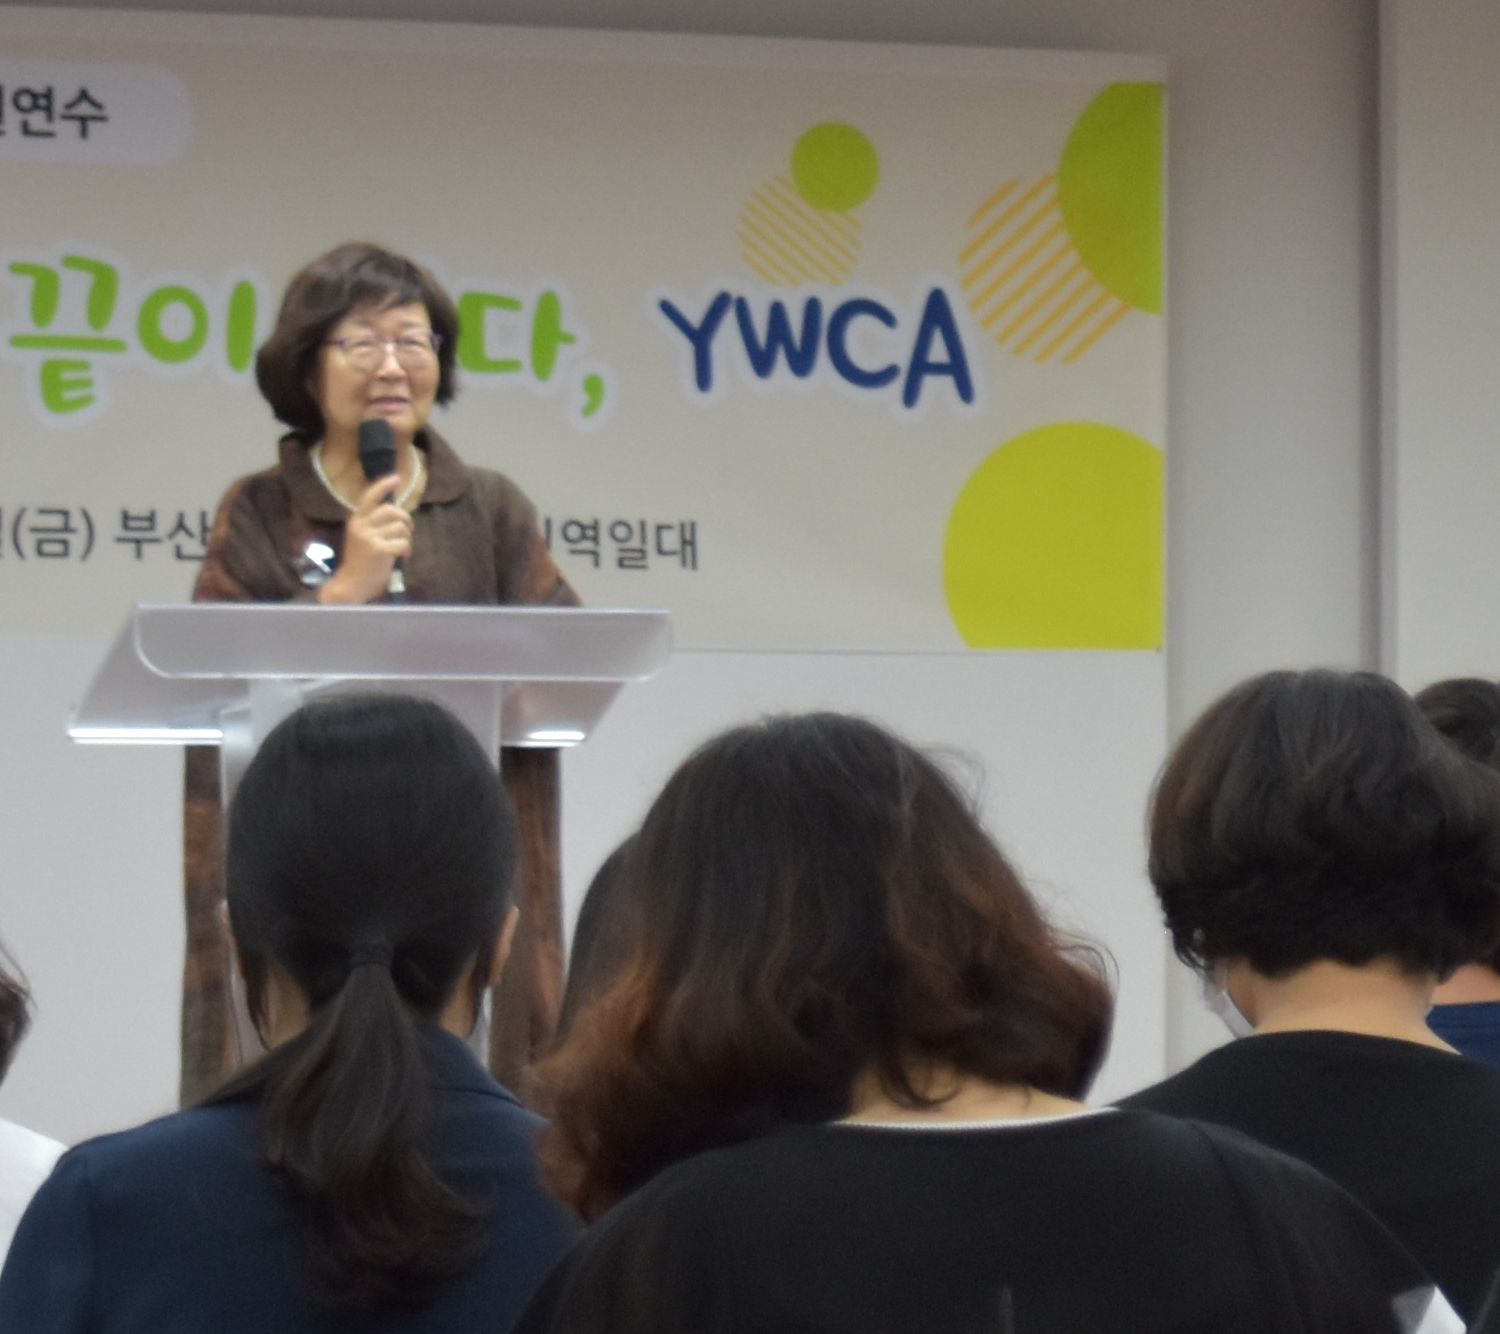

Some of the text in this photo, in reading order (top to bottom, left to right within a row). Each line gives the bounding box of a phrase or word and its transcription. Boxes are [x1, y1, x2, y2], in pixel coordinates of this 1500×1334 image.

[8, 254, 257, 414] 끝이
[456, 289, 605, 418] 다,
[658, 287, 974, 409] YWCA
[544, 517, 699, 571] 역일대
